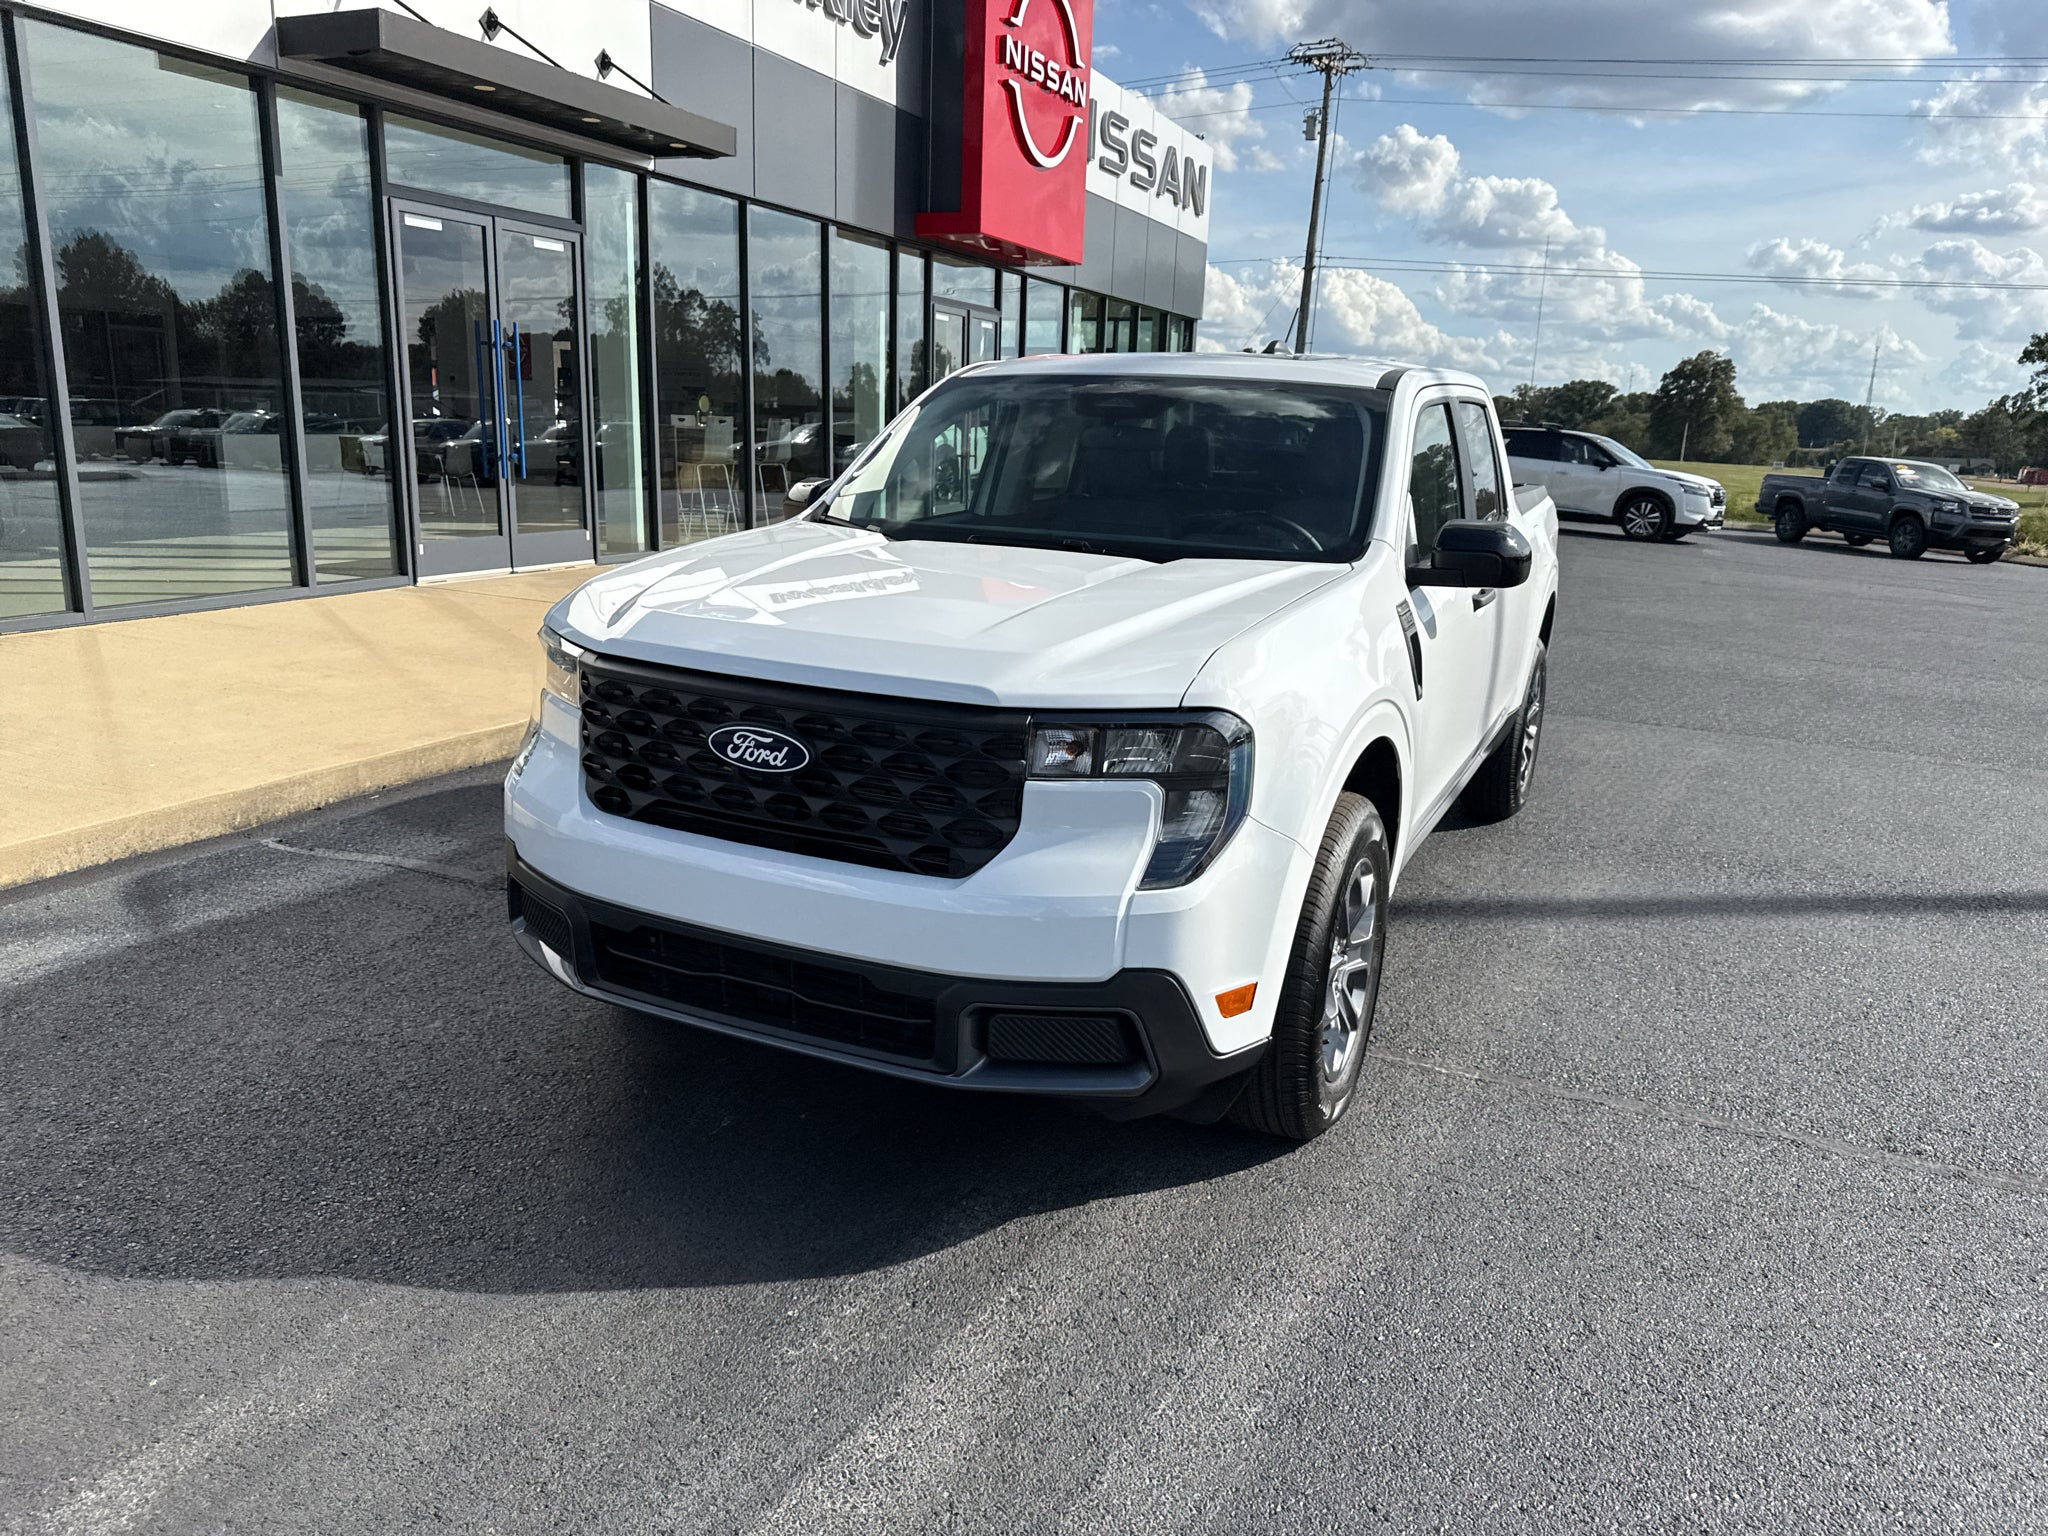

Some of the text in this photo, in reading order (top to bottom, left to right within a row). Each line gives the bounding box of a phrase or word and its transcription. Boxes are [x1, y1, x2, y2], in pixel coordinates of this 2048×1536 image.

[1003, 33, 1087, 108] NISSAN
[1087, 98, 1207, 218] ISSAN
[727, 731, 789, 767] Ford
